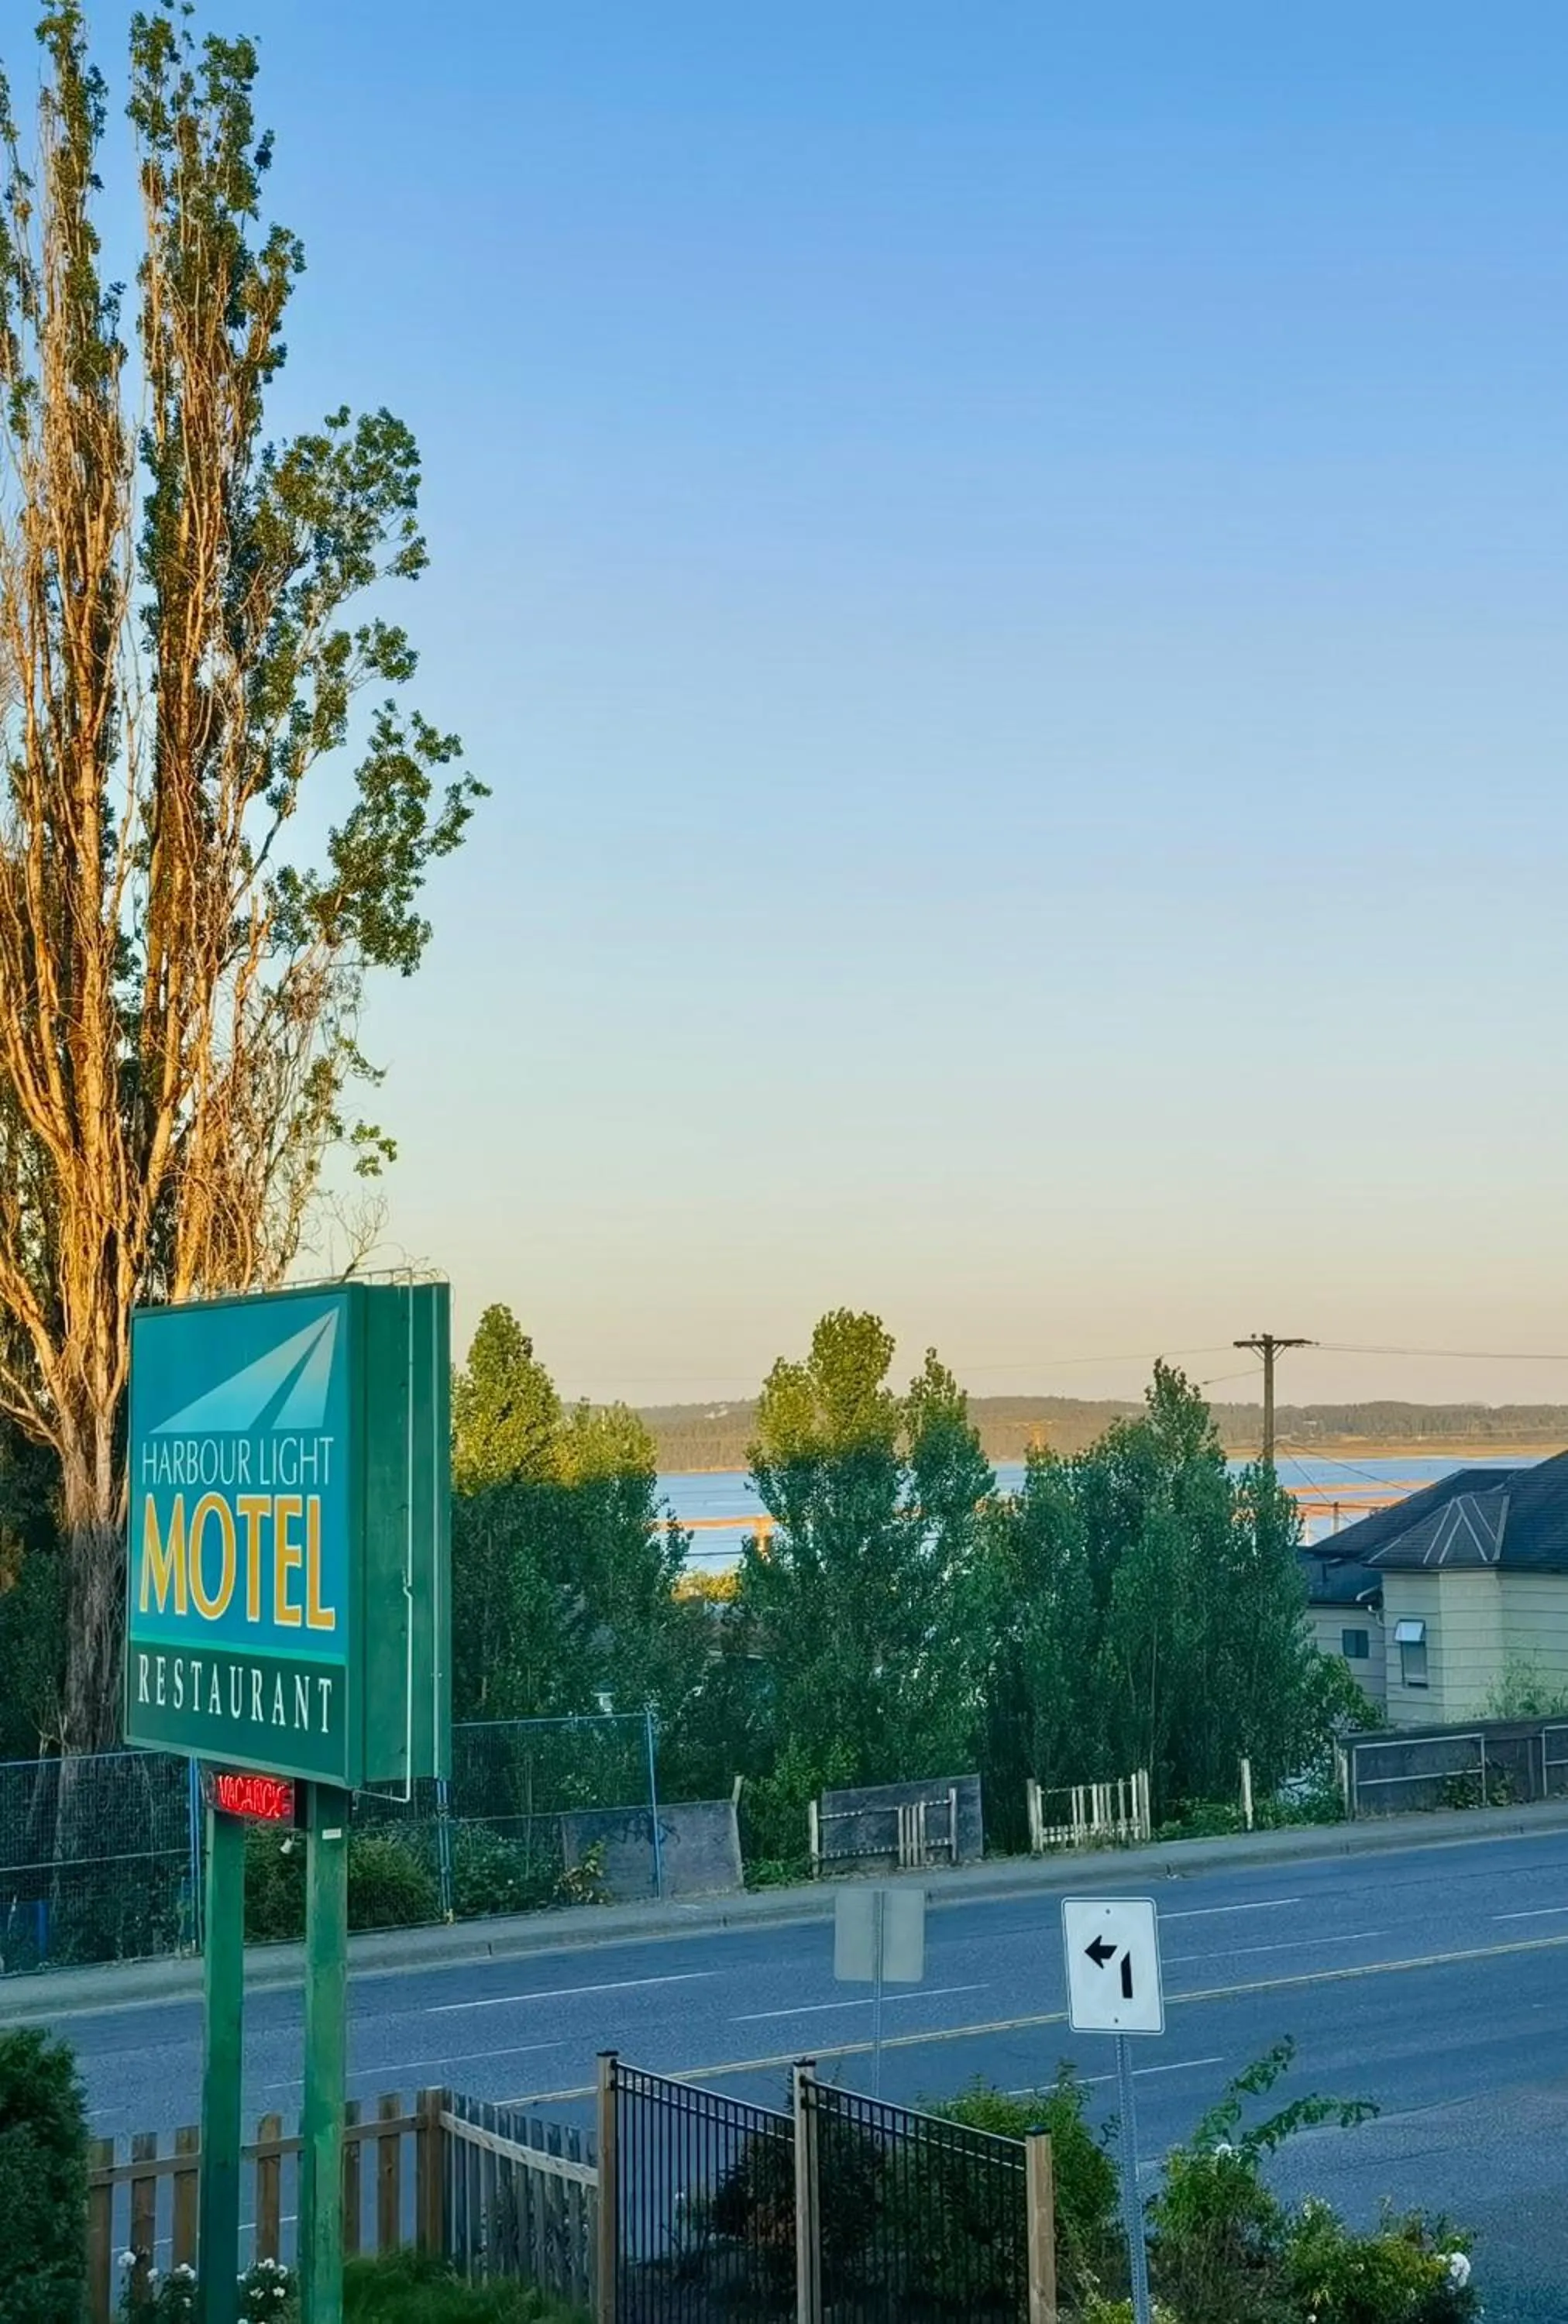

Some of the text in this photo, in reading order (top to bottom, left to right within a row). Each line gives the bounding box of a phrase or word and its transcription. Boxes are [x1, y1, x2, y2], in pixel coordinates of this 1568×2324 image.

[142, 1437, 334, 1485] HARBOUR LIGHT
[139, 1491, 335, 1631] MOTEL
[137, 1653, 332, 1734] RESTAURANT
